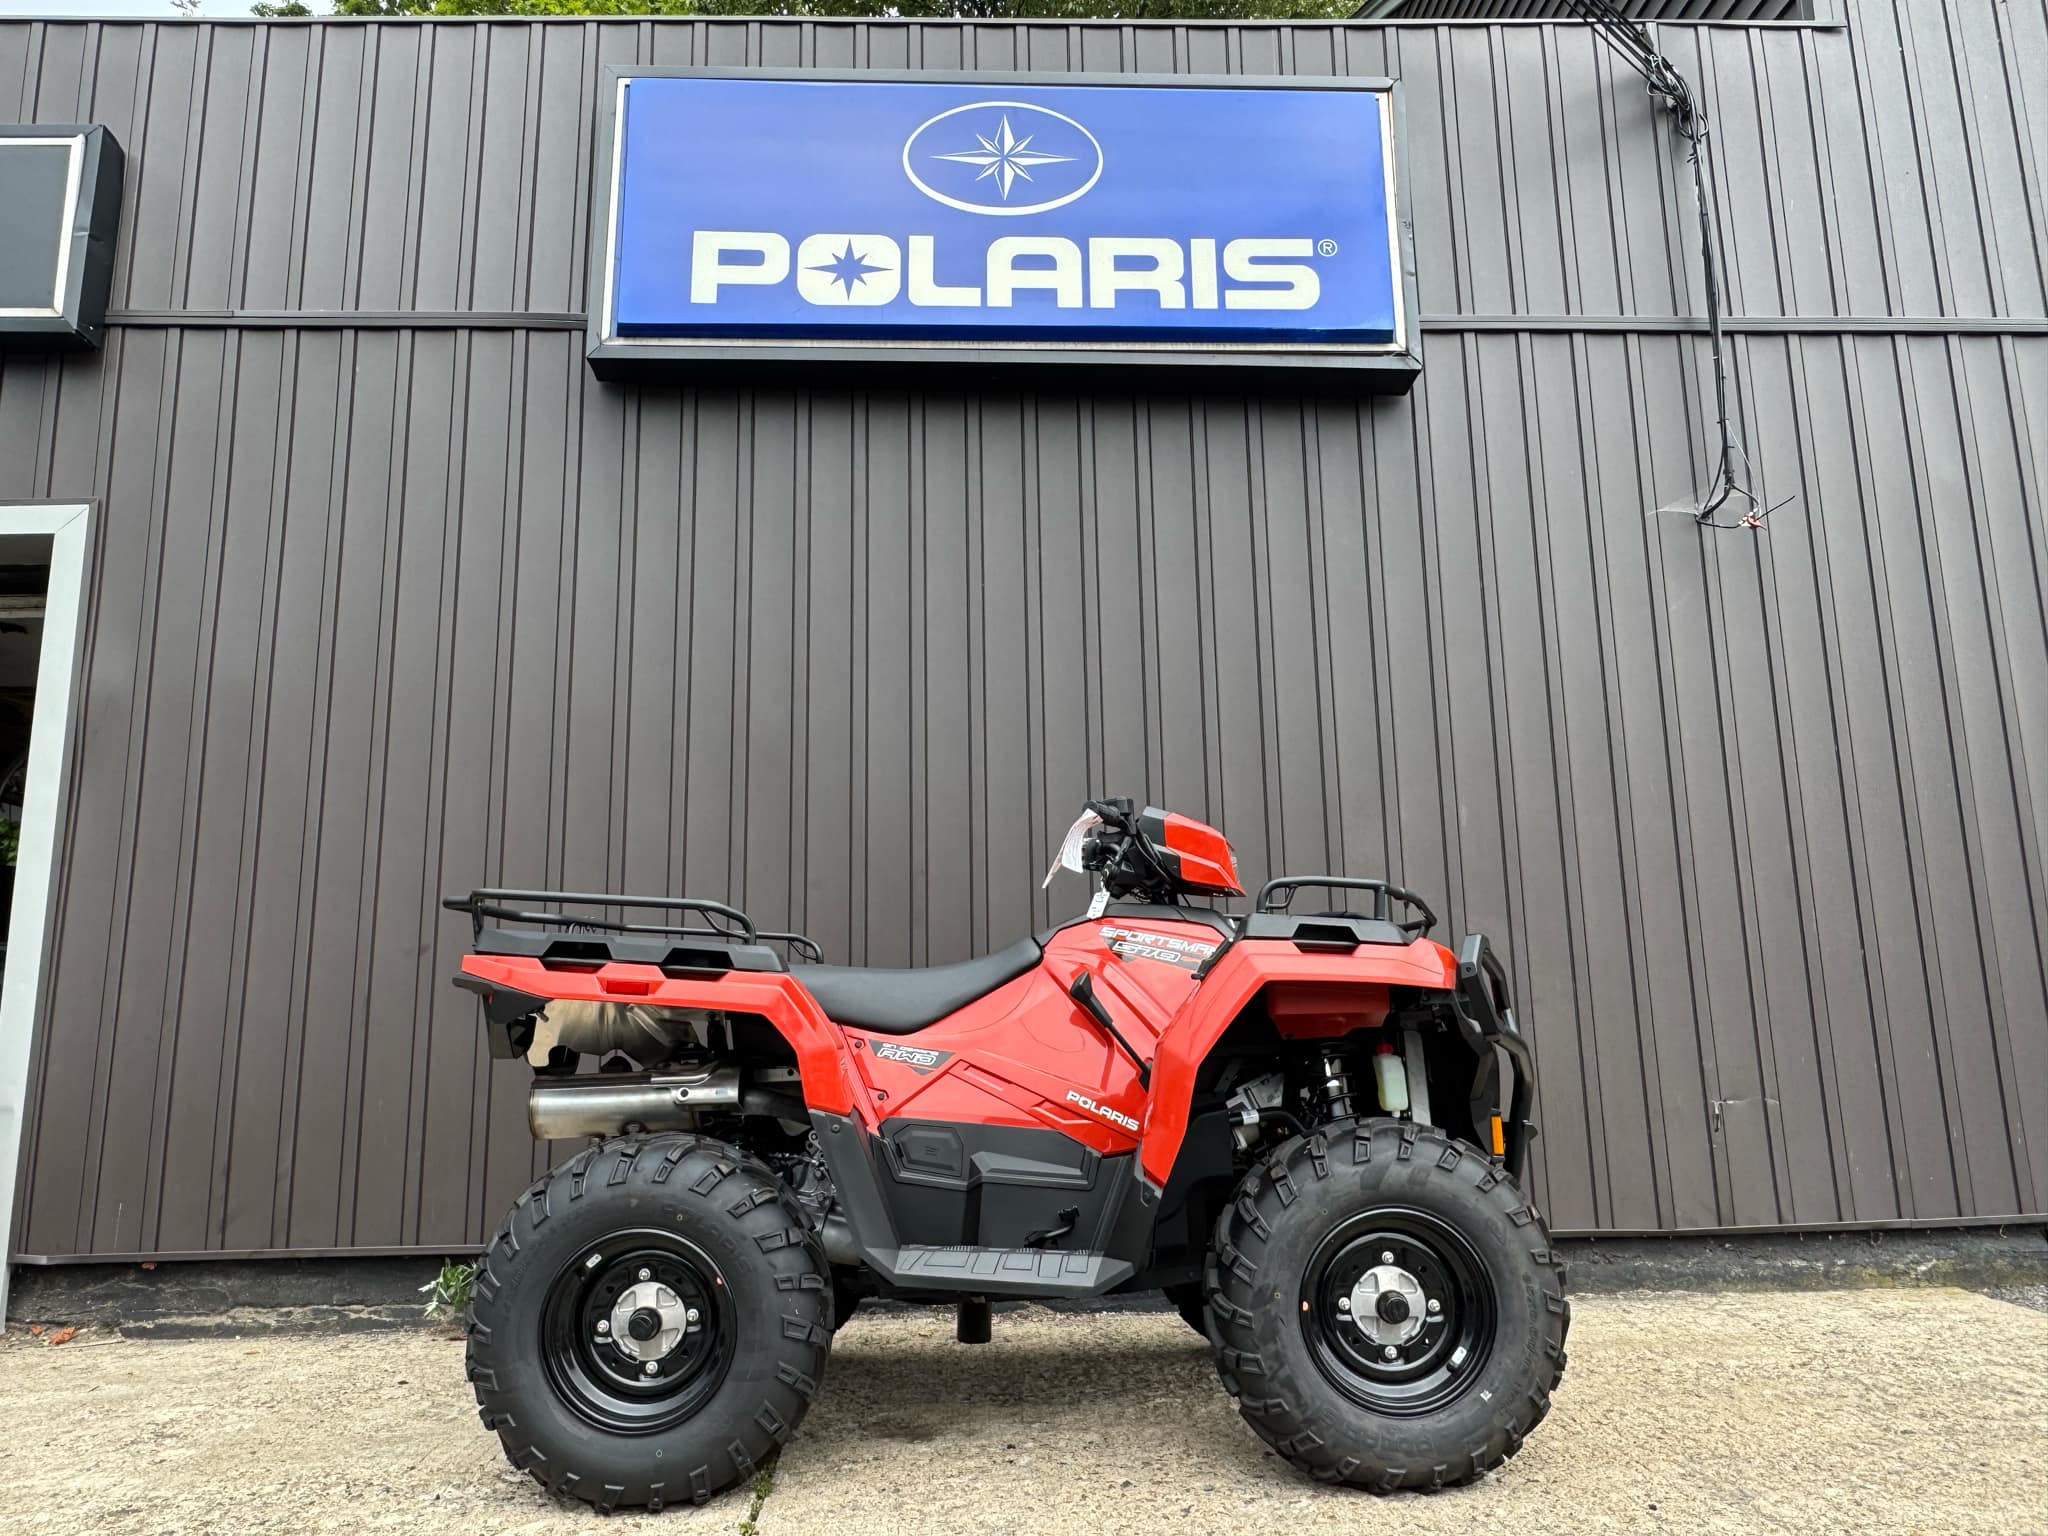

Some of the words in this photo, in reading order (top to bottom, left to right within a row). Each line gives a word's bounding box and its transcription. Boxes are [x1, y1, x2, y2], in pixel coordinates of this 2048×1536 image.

[1111, 941, 1180, 962] 570
[877, 1047, 936, 1066] AWD
[1066, 1090, 1140, 1132] POLARIS
